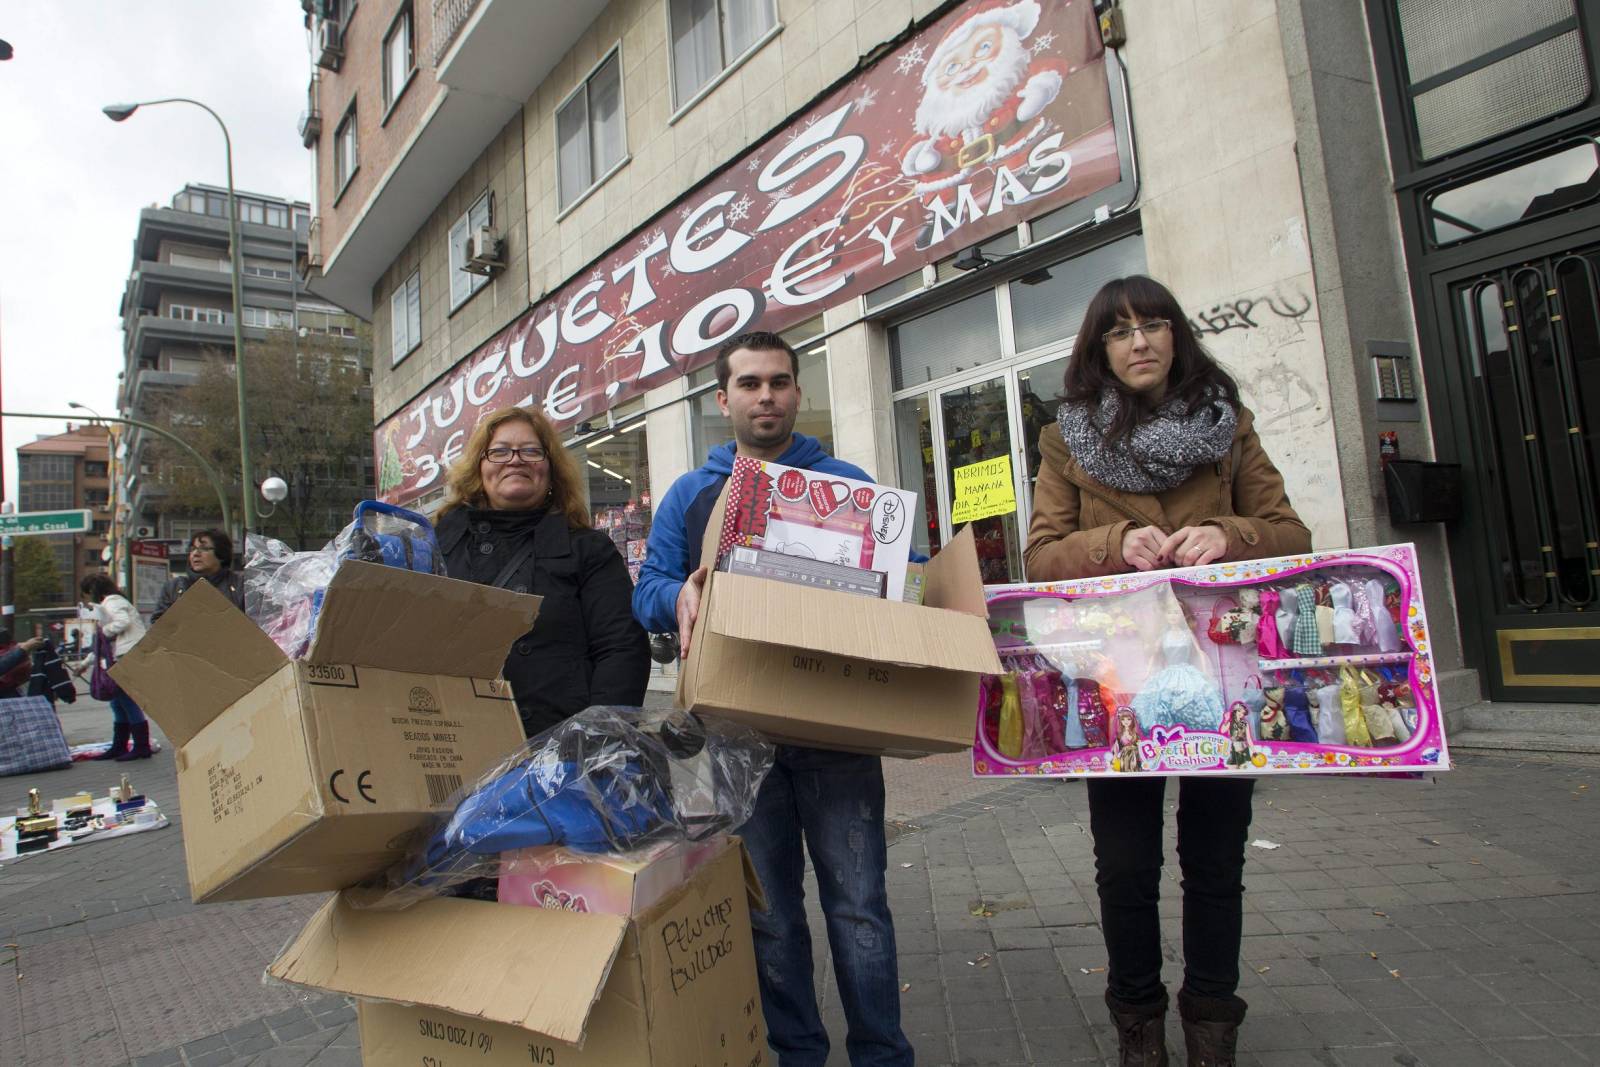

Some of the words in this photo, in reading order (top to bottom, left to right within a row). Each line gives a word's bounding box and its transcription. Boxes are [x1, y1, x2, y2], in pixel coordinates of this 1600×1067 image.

[868, 216, 905, 266] Y
[924, 131, 1073, 246] MAS
[405, 102, 867, 450] JUGUETES
[956, 461, 1005, 480] ABRIMOS
[955, 500, 970, 510] DIA
[973, 494, 988, 506] 21
[43, 521, 69, 530] Casal
[308, 664, 345, 681] 33500
[844, 664, 852, 678] 6
[867, 667, 890, 684] PCS
[1167, 756, 1217, 766] Fashion
[329, 769, 377, 804] CE
[419, 1019, 445, 1041] CTNS
